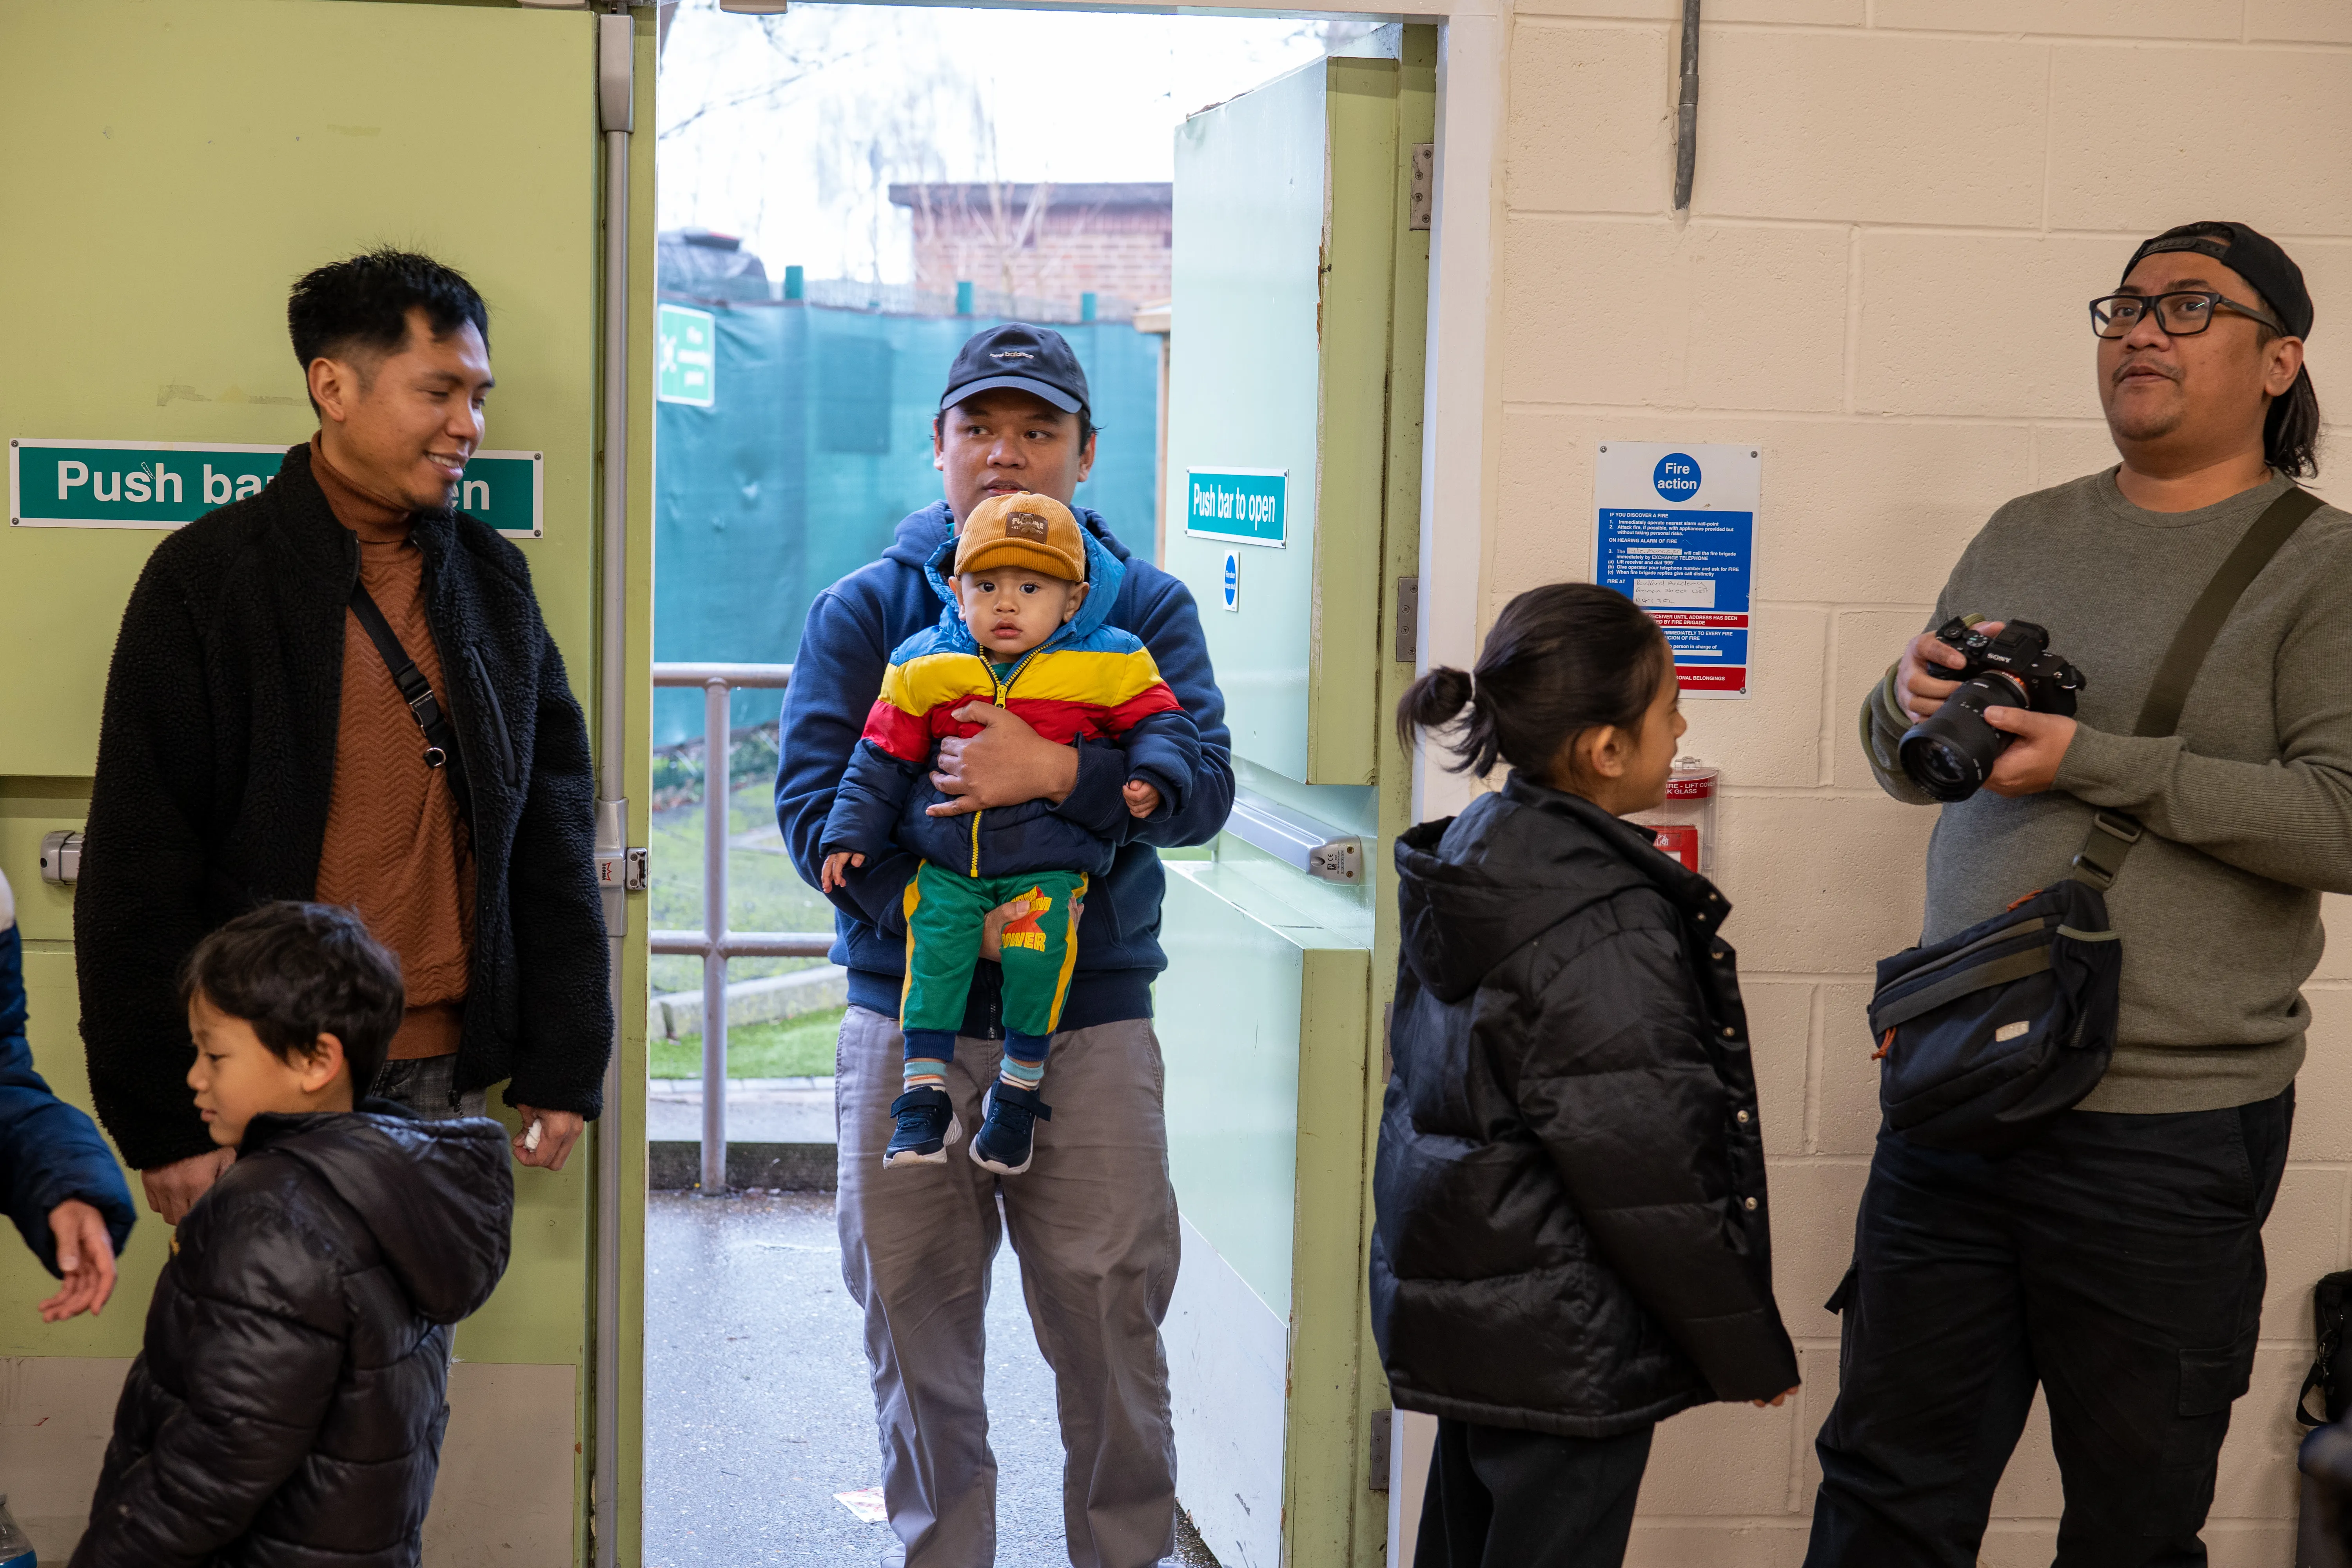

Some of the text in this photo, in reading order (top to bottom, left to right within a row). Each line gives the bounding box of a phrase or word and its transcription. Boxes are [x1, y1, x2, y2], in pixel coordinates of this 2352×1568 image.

[1666, 463, 1690, 474] Fire
[58, 460, 275, 504] Push ba
[1657, 478, 1697, 489] action
[1193, 483, 1275, 531] Push bar to open
[1987, 653, 2012, 663] SONY
[1002, 932, 1046, 952] POWER
